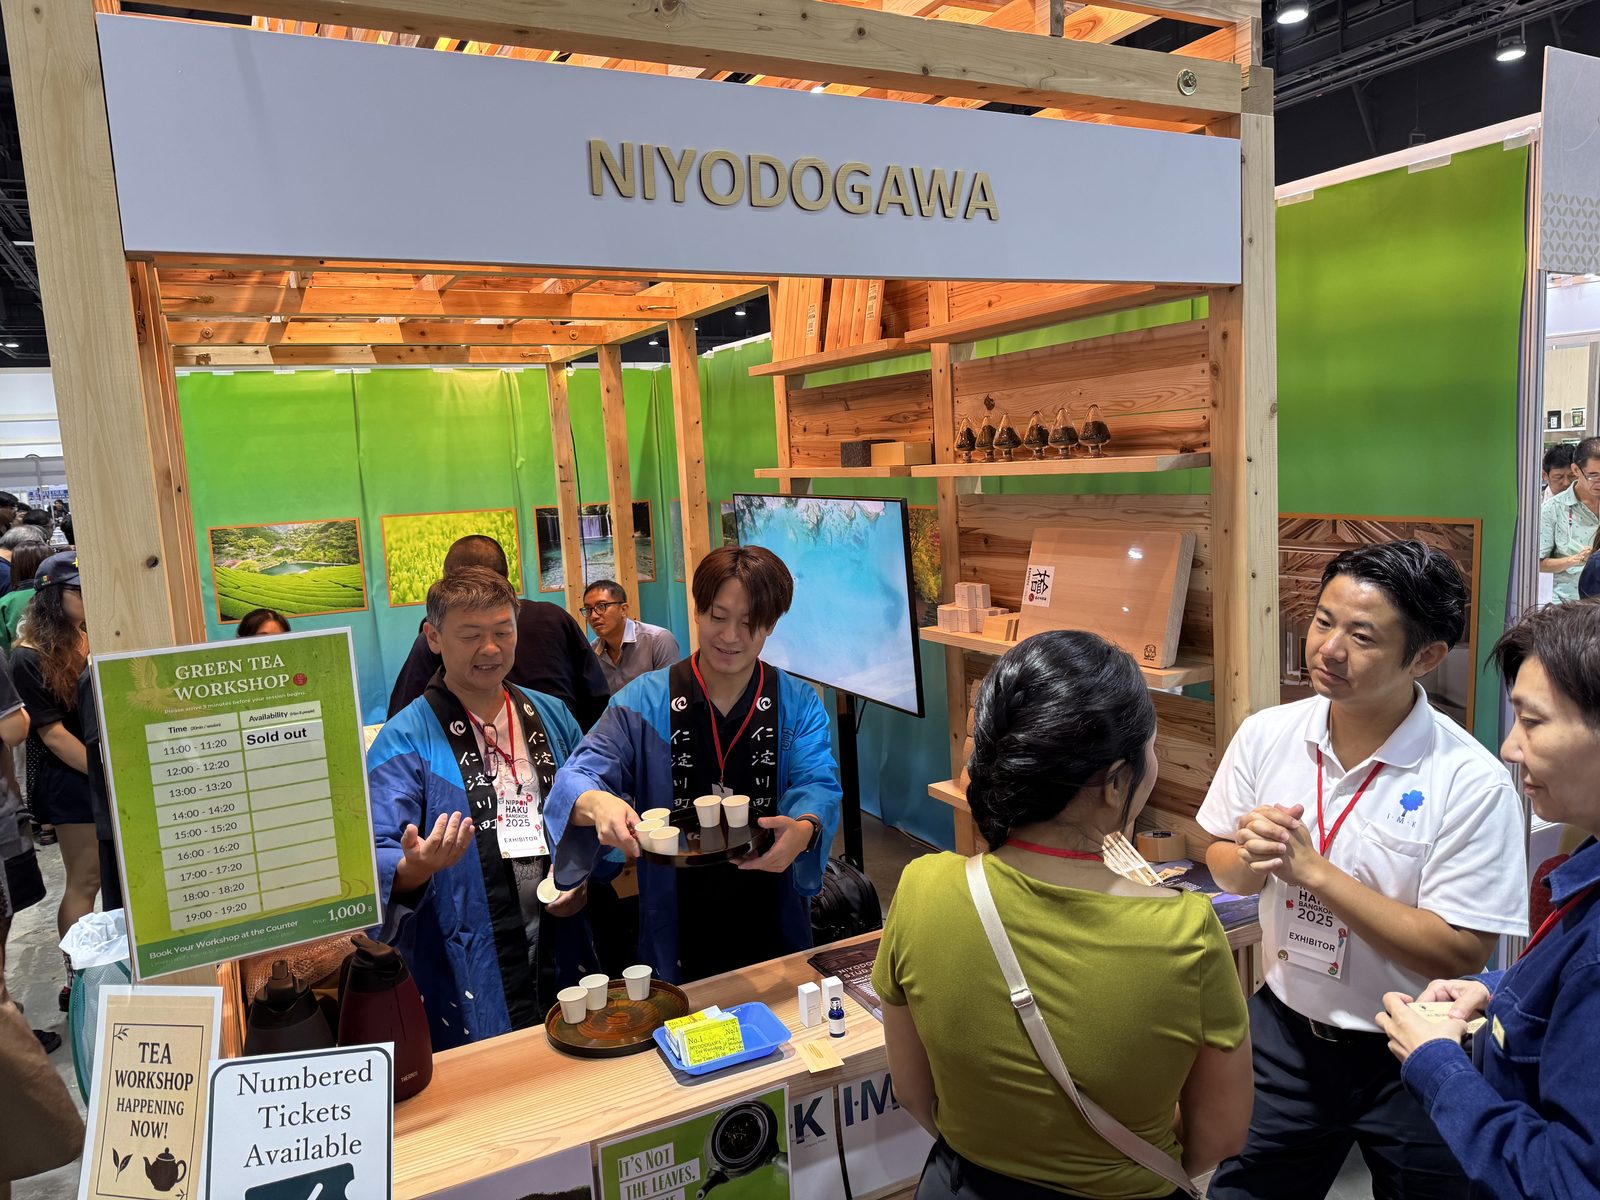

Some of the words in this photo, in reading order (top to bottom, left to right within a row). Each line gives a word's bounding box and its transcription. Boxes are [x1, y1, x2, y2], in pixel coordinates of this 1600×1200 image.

[587, 138, 1000, 222] NIYODOGAWA
[175, 659, 242, 680] GREEN
[247, 654, 285, 671] TEA
[173, 673, 290, 701] WORKSHOP
[208, 701, 232, 709] minutes
[233, 698, 250, 706] before
[249, 711, 288, 722] Availability
[168, 725, 188, 734] Time
[246, 731, 279, 746] Sold
[284, 727, 307, 740] out
[164, 744, 191, 756] 11:00
[200, 739, 227, 750] 11:20
[166, 765, 194, 777] 12:00
[203, 760, 230, 771] 12:20
[751, 726, 776, 808] 仁淀川町
[169, 786, 196, 798] 13:00
[206, 781, 232, 792] 13:20
[460, 751, 497, 831] 仁淀川町
[172, 809, 199, 821] 14:00
[208, 803, 235, 815] 14:20
[505, 806, 529, 814] HAKU
[175, 828, 202, 840] 15:00
[211, 822, 237, 834] 15:20
[505, 819, 531, 827] 2025
[177, 848, 205, 861] 16:00
[213, 842, 240, 855] 16:20
[180, 869, 207, 882] 17:00
[216, 862, 243, 875] 17:20
[182, 890, 210, 902] 18:00
[218, 882, 245, 895] 18:20
[185, 910, 212, 923] 19:00
[221, 902, 247, 915] 19:20
[327, 902, 366, 923] 1,000
[1297, 908, 1334, 928] 2025
[149, 949, 173, 960] Book
[174, 944, 194, 955] Your
[196, 934, 240, 951] Workshop
[250, 927, 265, 937] the
[266, 919, 299, 934] Counter
[1288, 931, 1336, 952] EXHIBITOR
[138, 1042, 172, 1064] TEA
[115, 1069, 194, 1091] WORKSHOP
[237, 1059, 373, 1096] Numbered
[116, 1097, 184, 1116] HAPPENING
[257, 1101, 351, 1129] Tickets
[129, 1119, 168, 1139] NOW!
[243, 1132, 362, 1168] Available
[618, 1156, 642, 1178] IT'S
[646, 1148, 671, 1170] NOT
[625, 1180, 648, 1200] THE
[652, 1165, 696, 1192] LEAVES,
